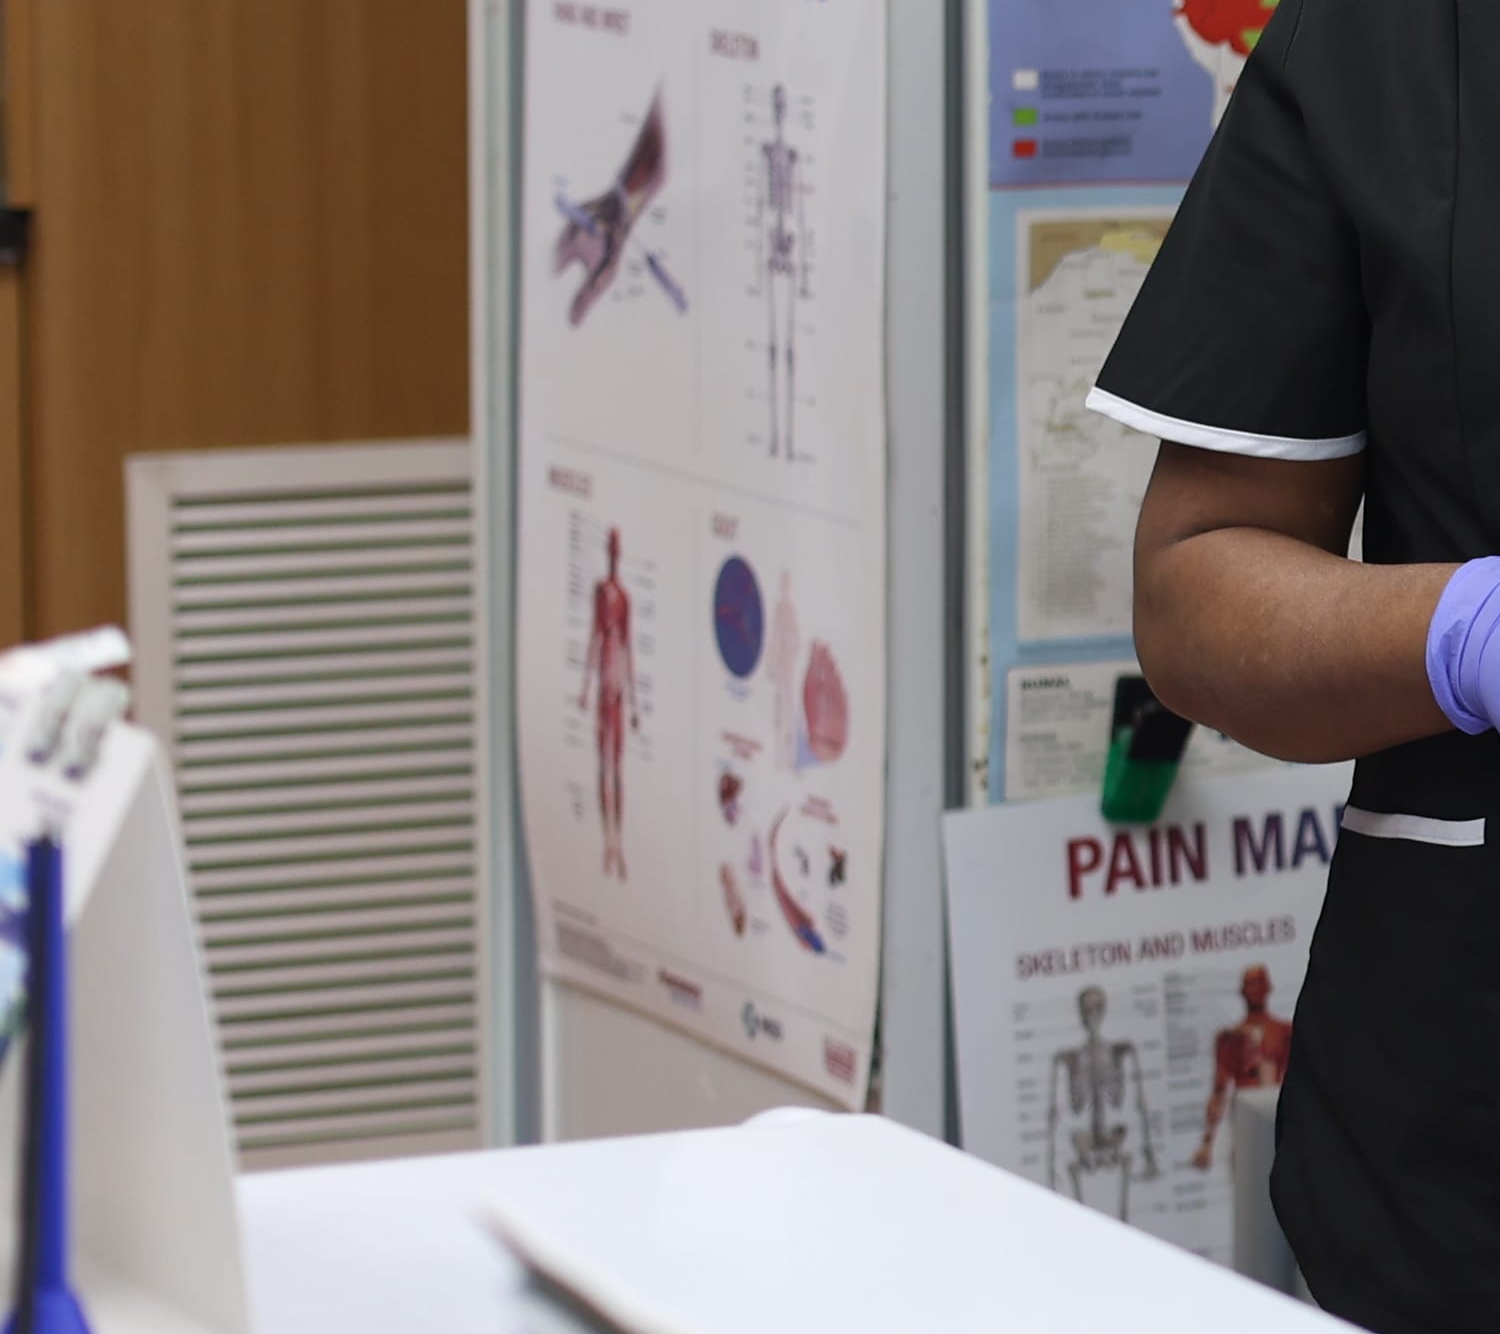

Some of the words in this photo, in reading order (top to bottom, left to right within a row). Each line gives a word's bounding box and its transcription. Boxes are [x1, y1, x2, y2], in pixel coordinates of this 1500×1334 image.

[1066, 821, 1209, 902] PAIN
[1015, 942, 1131, 980] SKELETON
[1139, 936, 1185, 962] AND
[1188, 915, 1296, 953] MUSCLES
